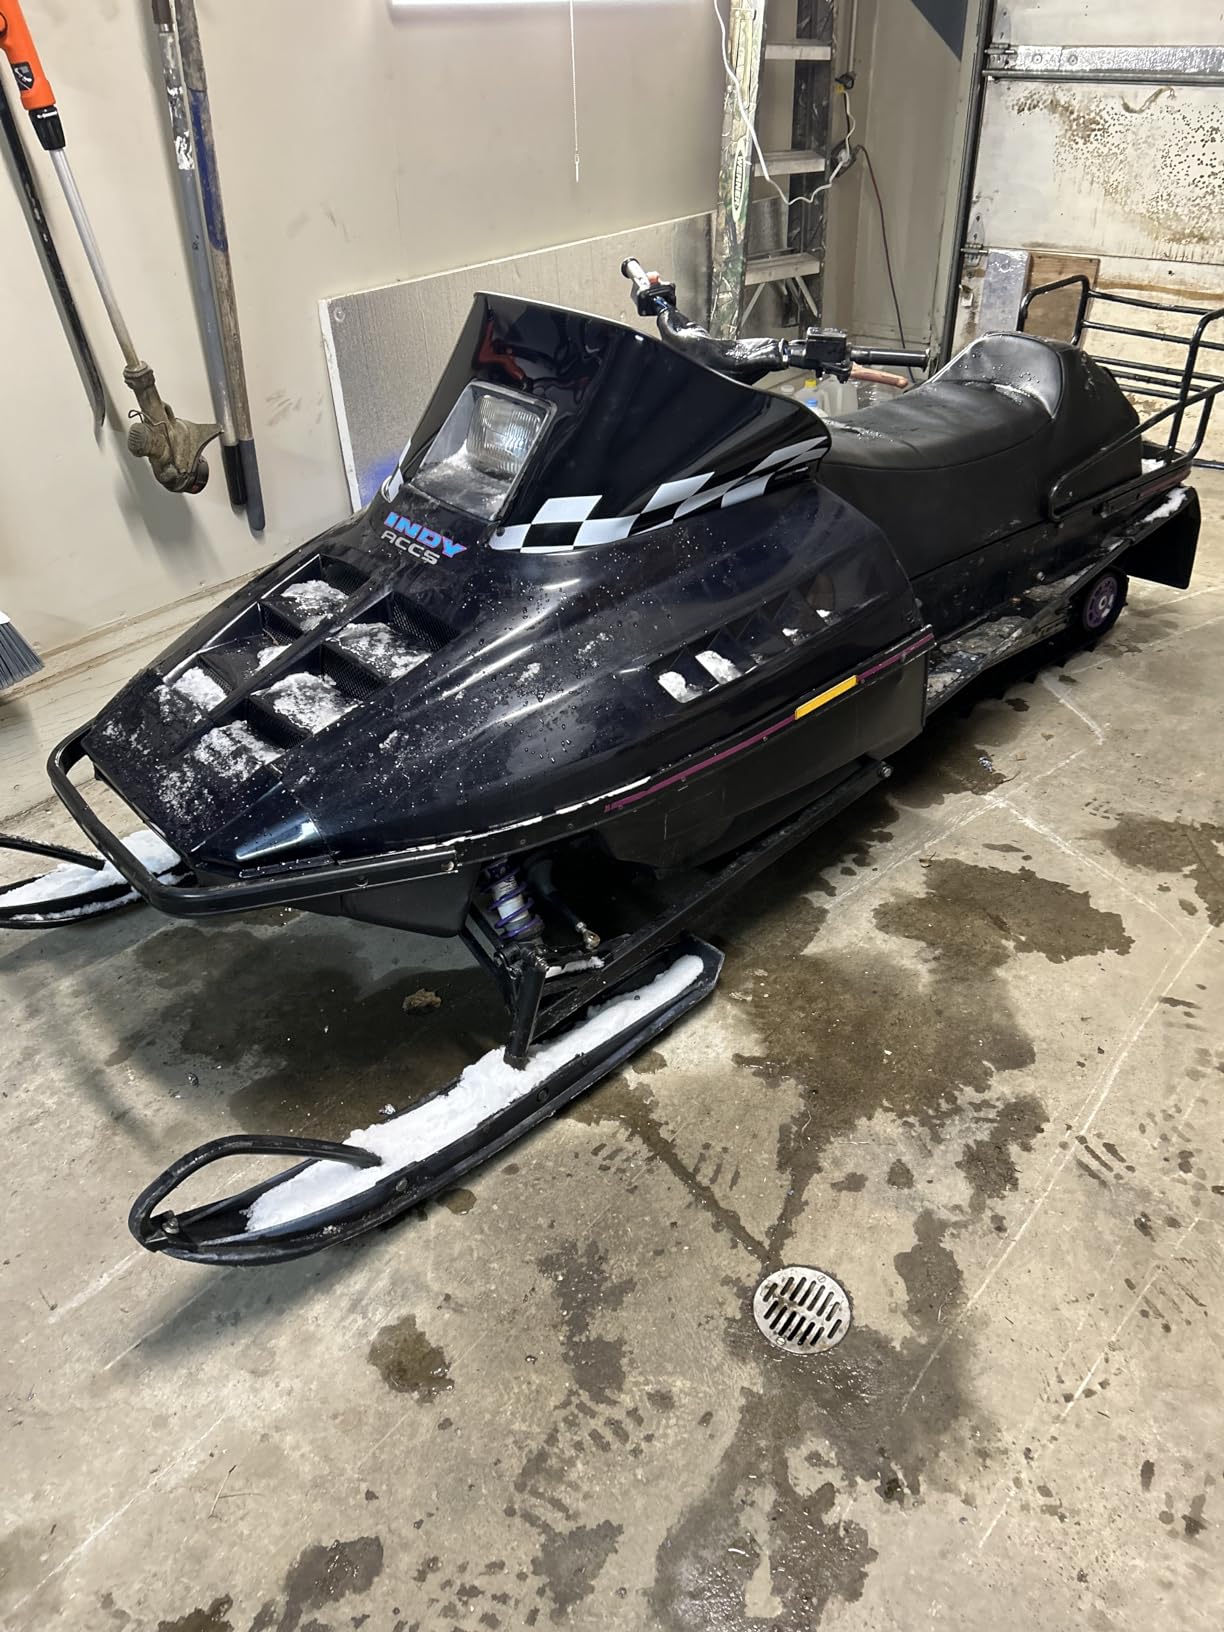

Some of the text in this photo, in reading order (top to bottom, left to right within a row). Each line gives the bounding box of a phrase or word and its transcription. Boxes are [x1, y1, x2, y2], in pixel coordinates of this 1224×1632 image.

[734, 155, 744, 206] WERNER
[380, 530, 440, 565] ACCS
[383, 511, 467, 558] INDY
